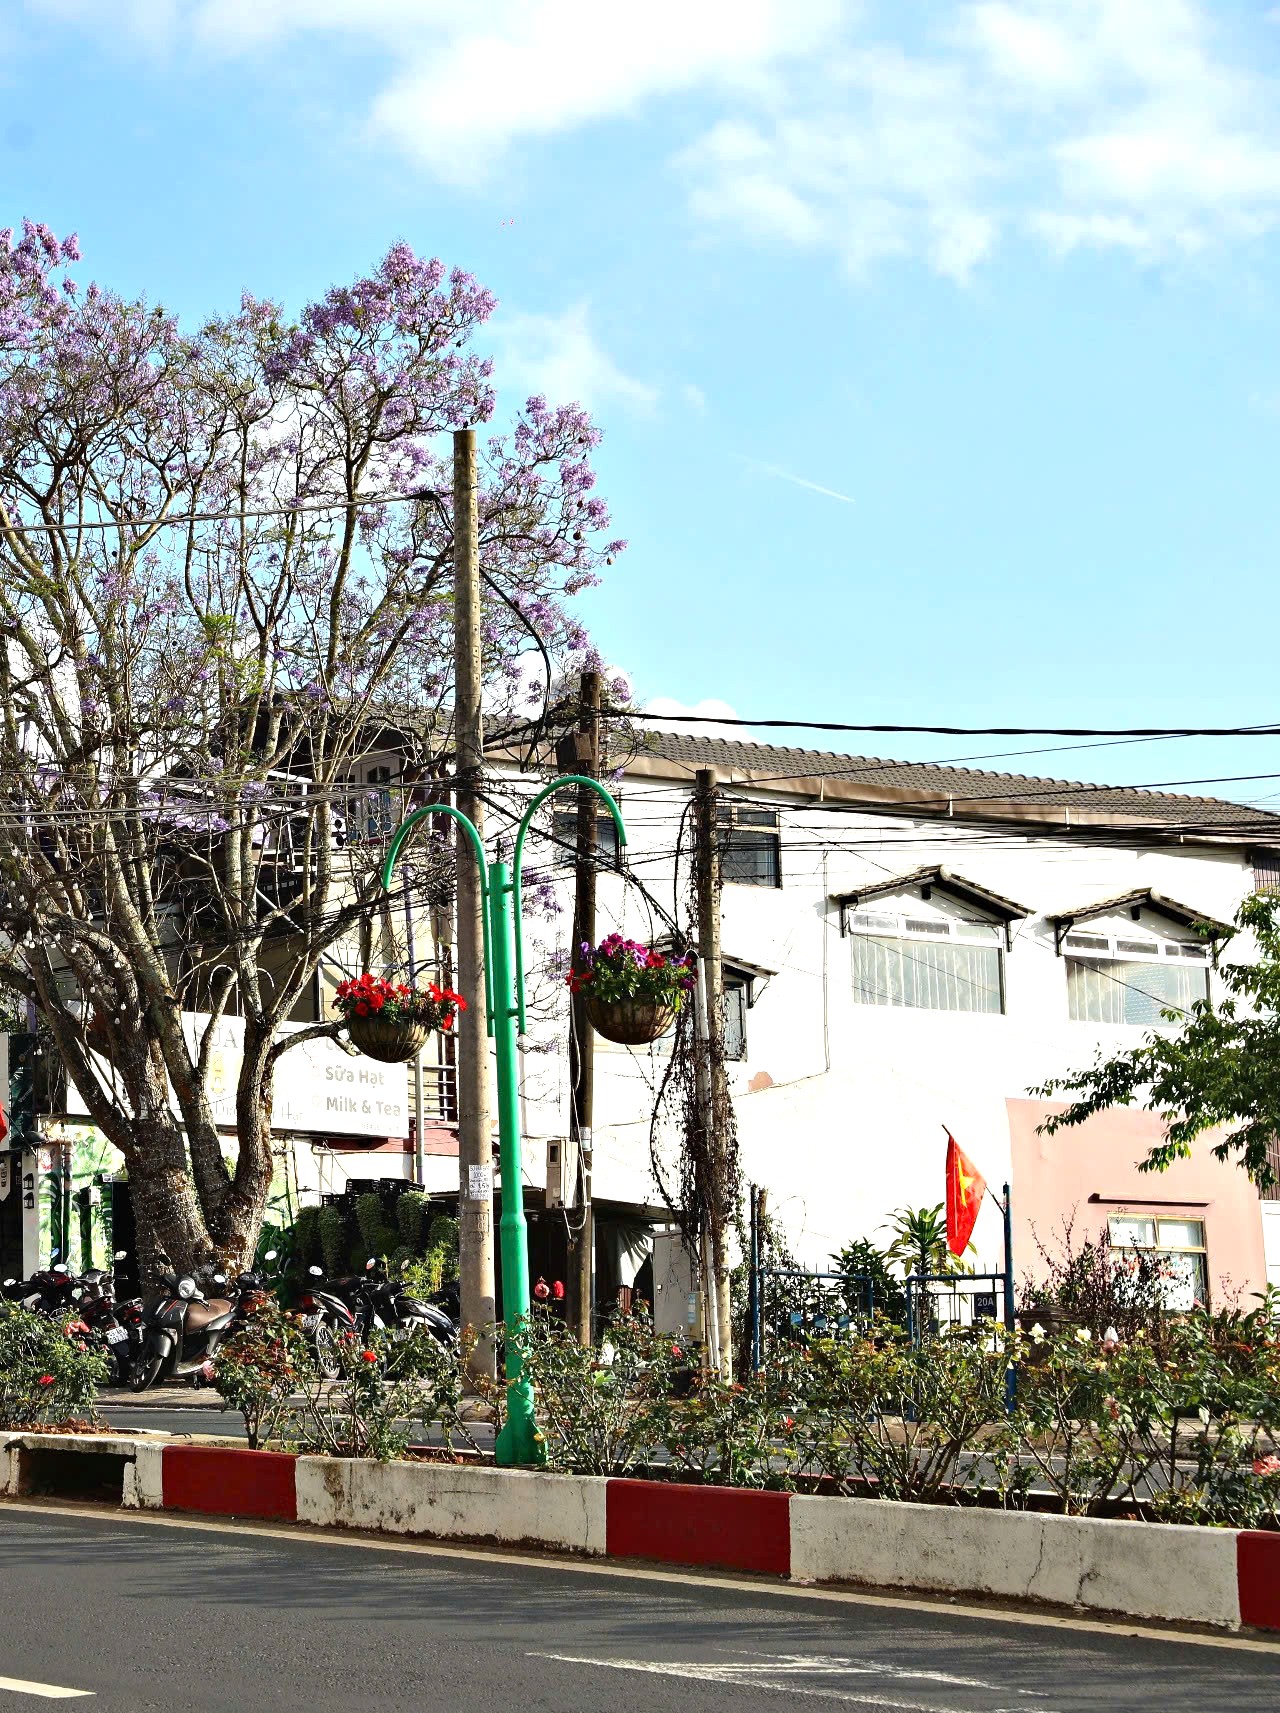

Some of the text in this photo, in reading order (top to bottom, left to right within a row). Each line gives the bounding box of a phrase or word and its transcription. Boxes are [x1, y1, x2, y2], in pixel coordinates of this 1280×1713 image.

[325, 1065, 385, 1089] Sữa Hạt
[326, 1095, 401, 1117] Milk & Tea
[977, 1297, 994, 1307] 20A
